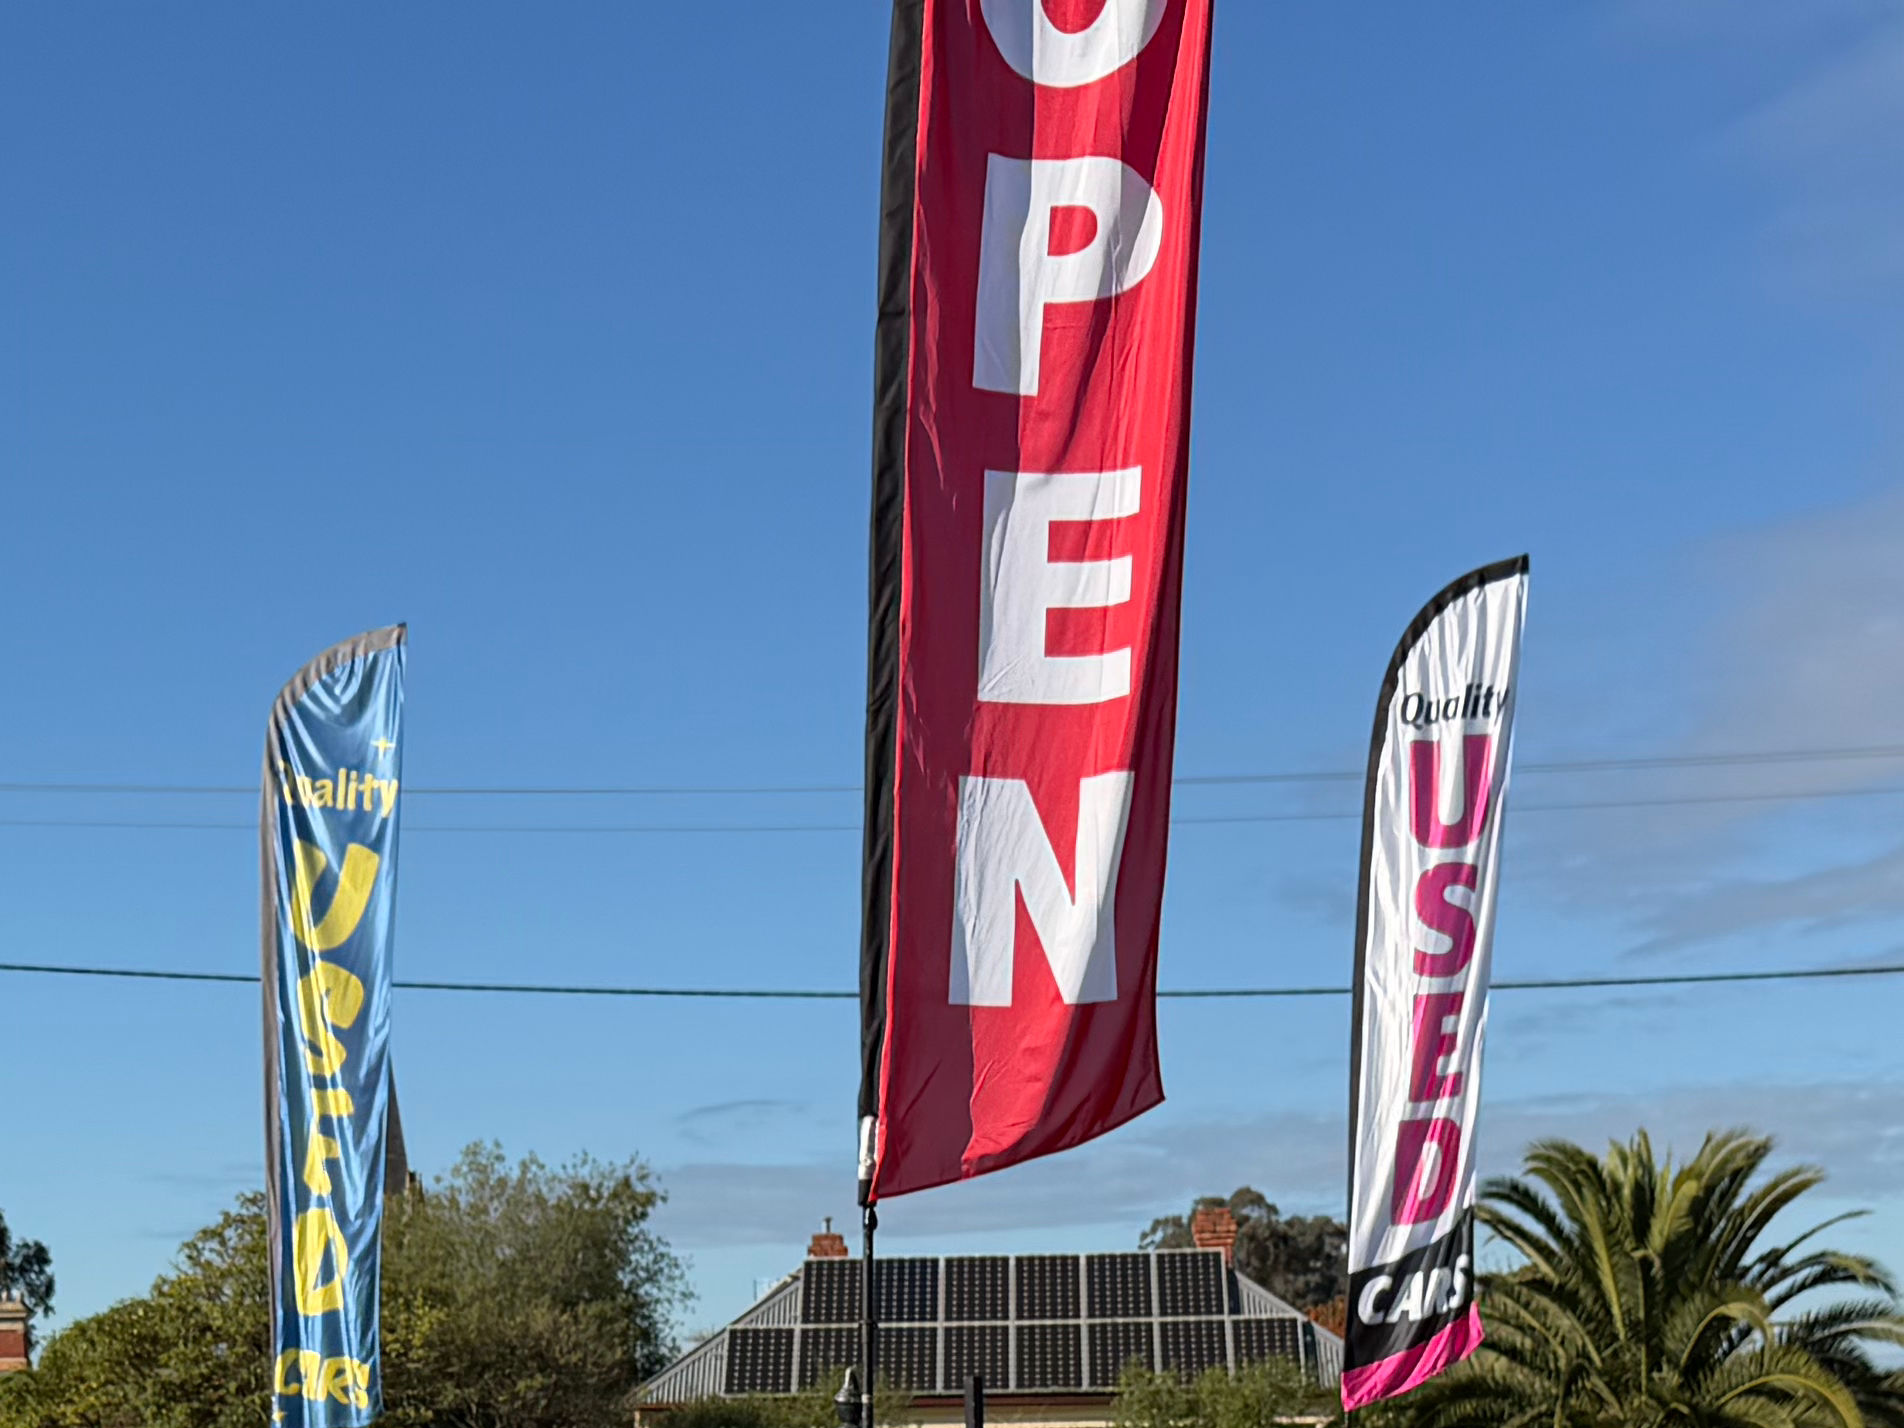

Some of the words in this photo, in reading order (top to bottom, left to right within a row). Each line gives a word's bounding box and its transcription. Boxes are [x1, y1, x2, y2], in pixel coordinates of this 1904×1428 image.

[1401, 682, 1510, 730] Quality
[1391, 733, 1492, 1227] USED
[1358, 1253, 1469, 1325] CARS
